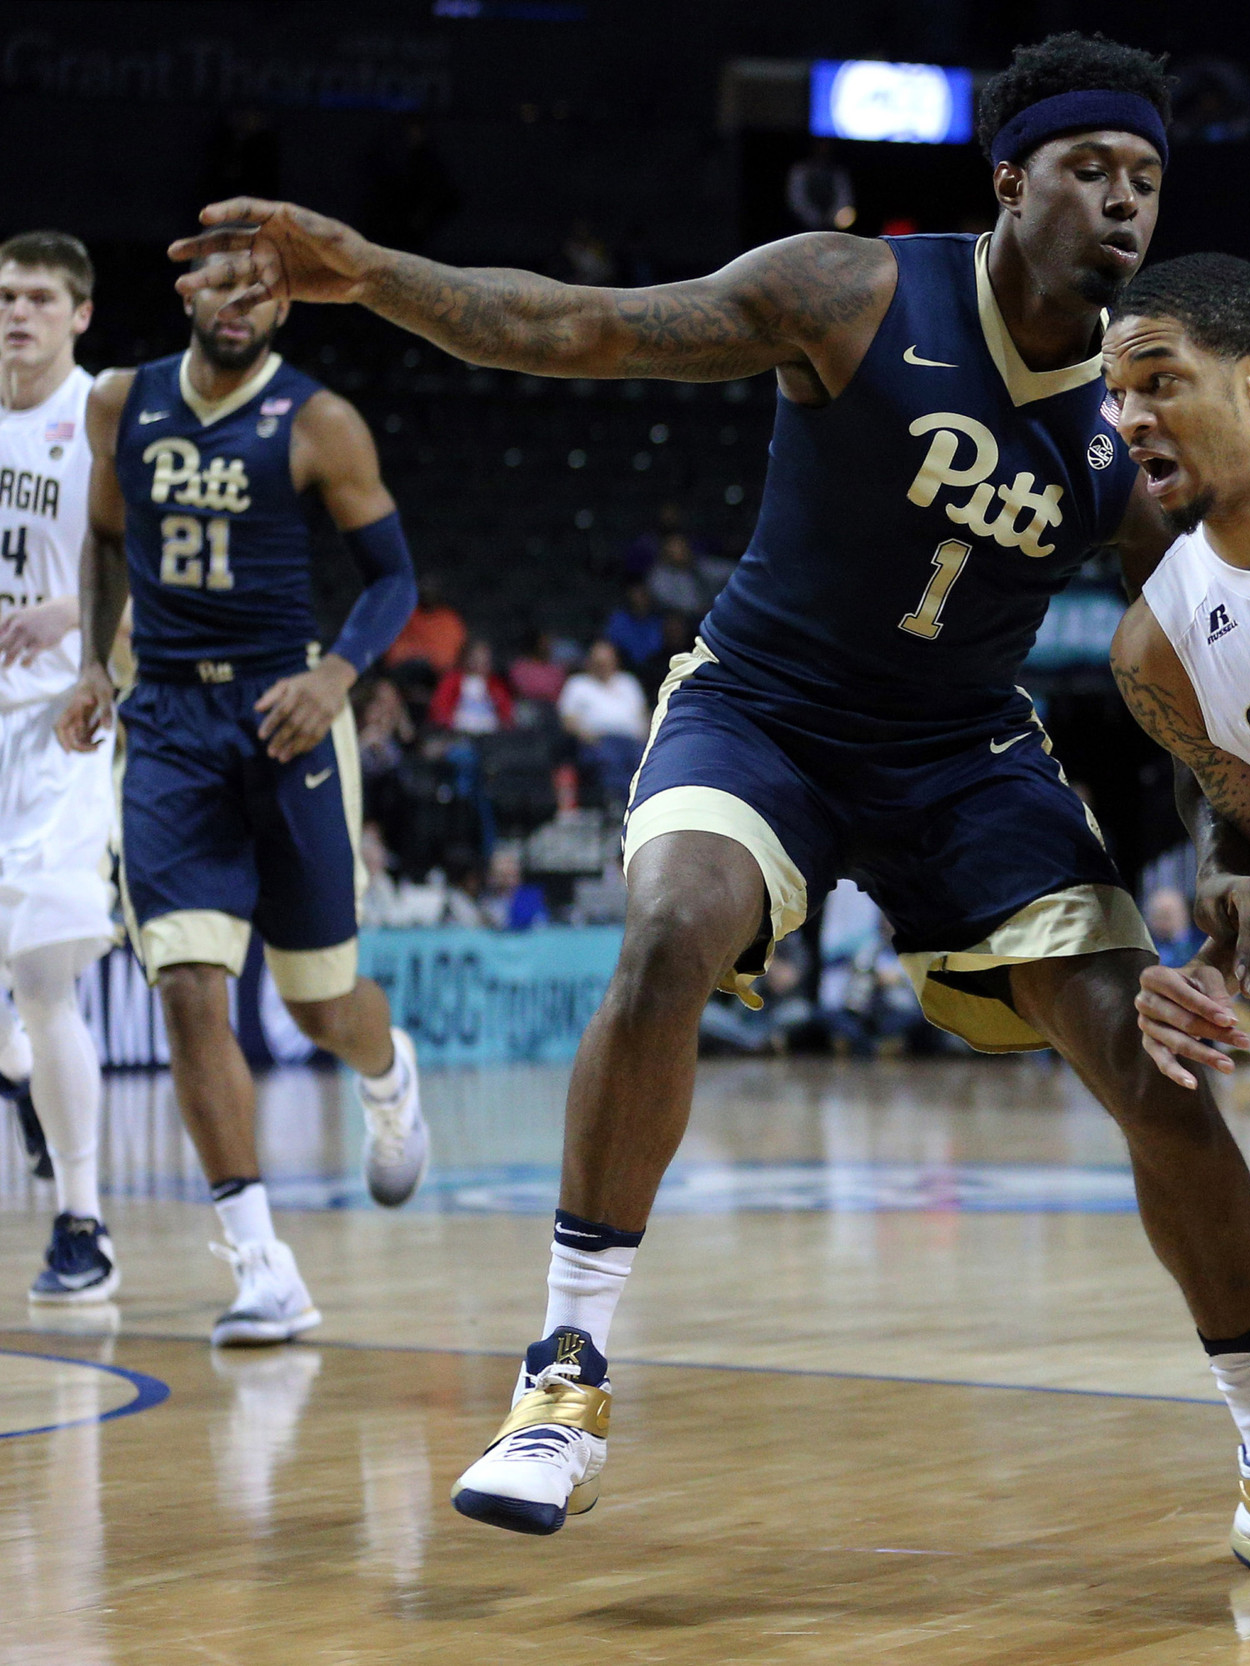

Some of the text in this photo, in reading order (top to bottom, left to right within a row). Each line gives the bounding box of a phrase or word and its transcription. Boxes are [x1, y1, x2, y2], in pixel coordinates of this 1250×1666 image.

[142, 437, 251, 514] Pitt
[906, 412, 1064, 557] Pitt
[2, 525, 27, 577] 4
[160, 514, 235, 591] 21
[898, 538, 972, 640] 1
[1207, 620, 1238, 645] RUSSELL
